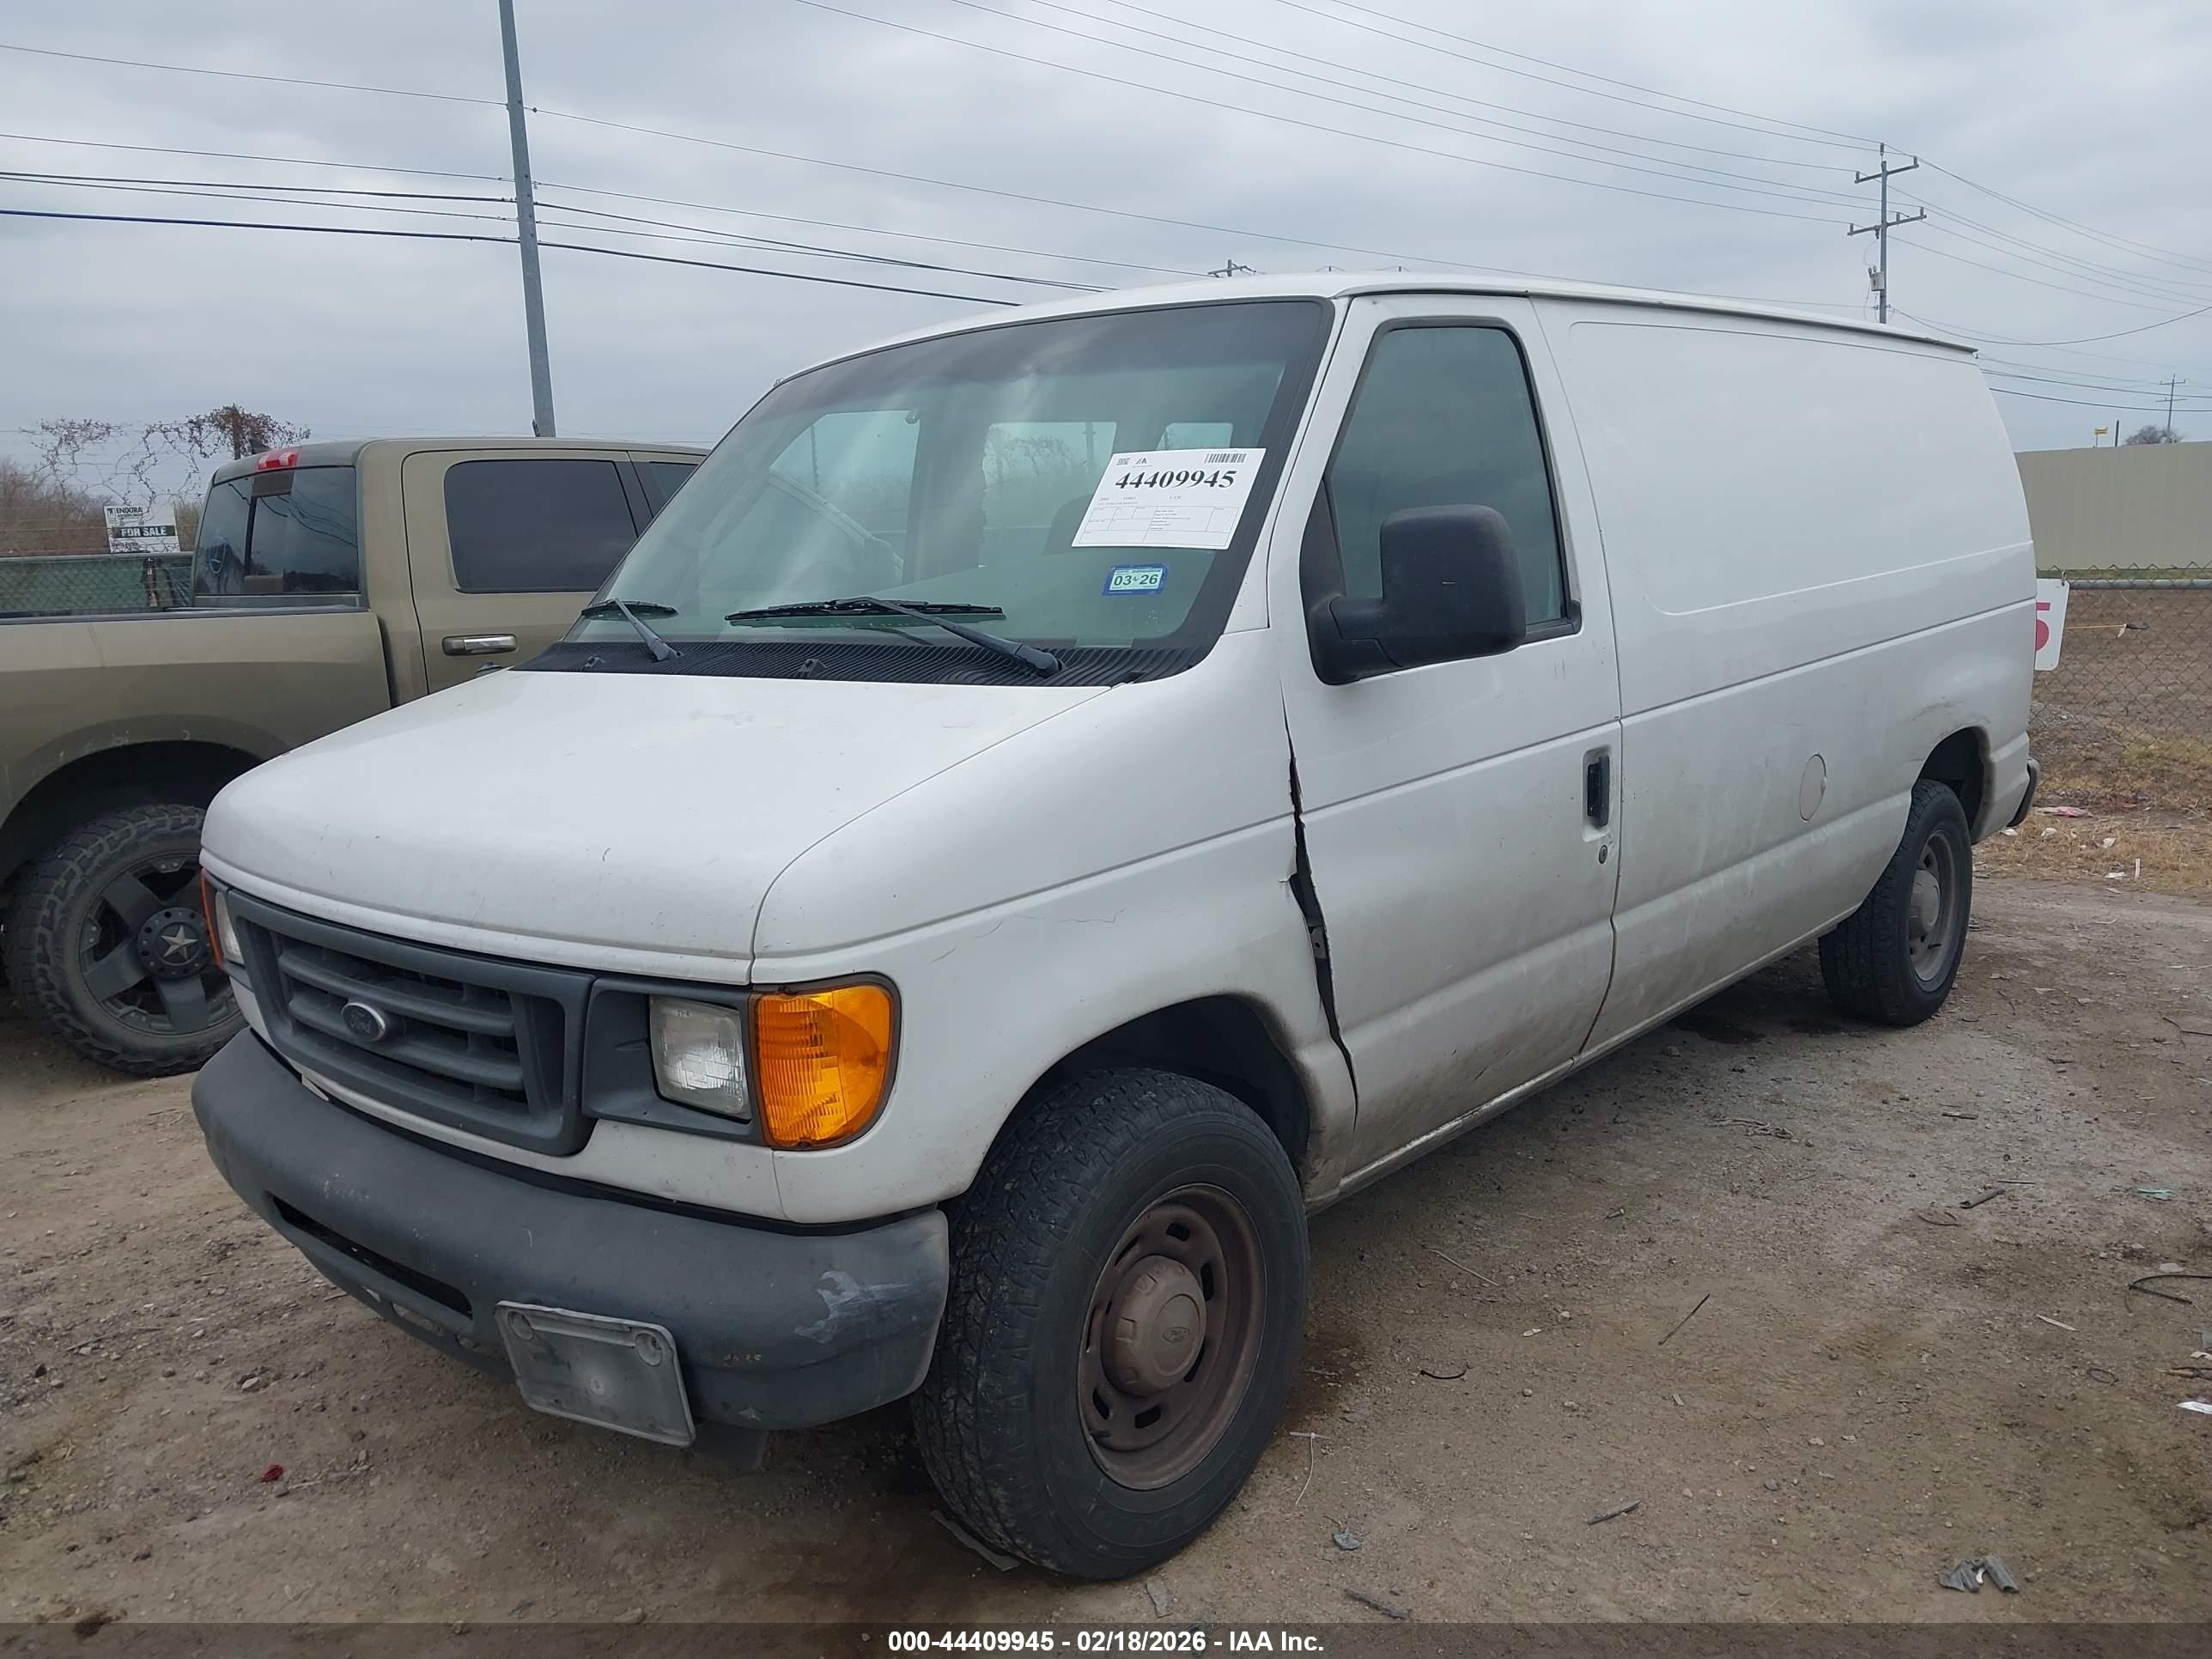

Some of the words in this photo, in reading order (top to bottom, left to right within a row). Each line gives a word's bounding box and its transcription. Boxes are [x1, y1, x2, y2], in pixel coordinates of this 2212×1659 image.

[1115, 470, 1237, 489] 44409945
[121, 527, 141, 537] FOR
[143, 526, 167, 536] SALE
[1114, 574, 1132, 586] 03
[1139, 574, 1159, 585] 26
